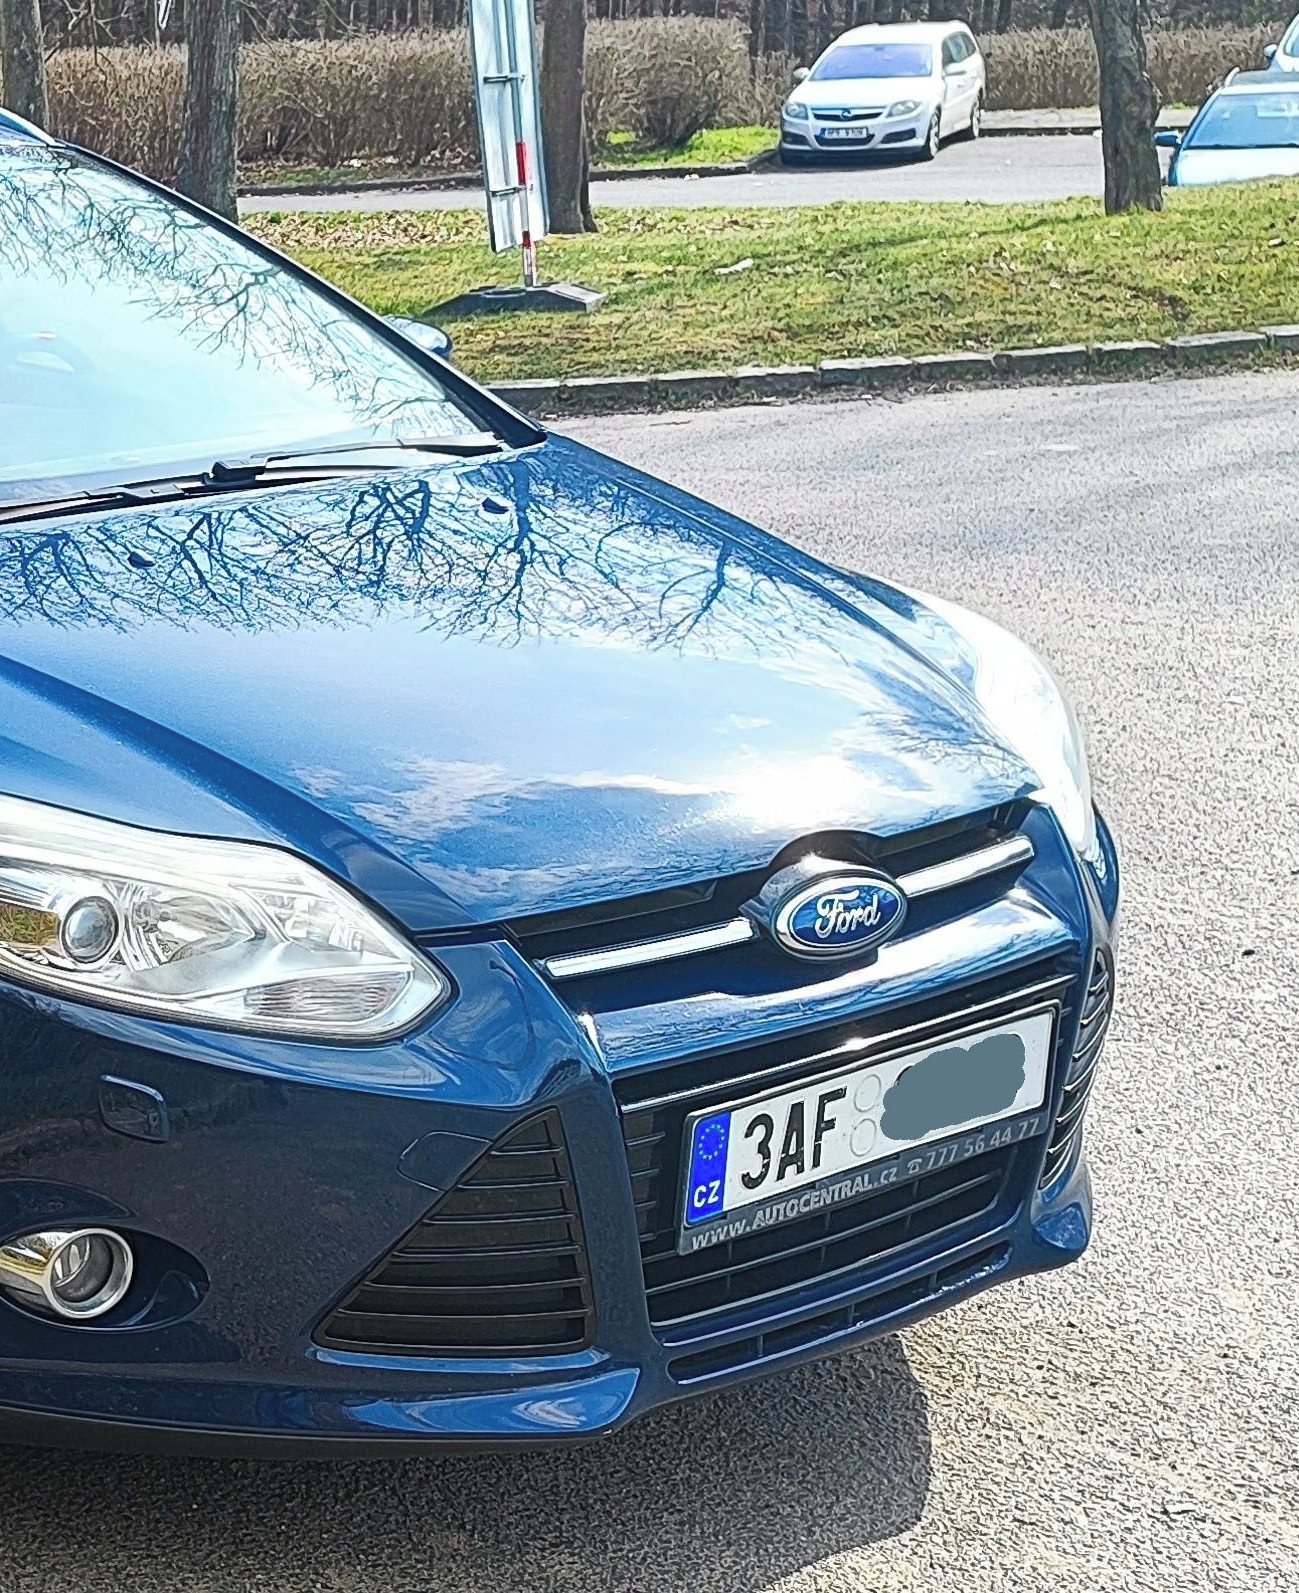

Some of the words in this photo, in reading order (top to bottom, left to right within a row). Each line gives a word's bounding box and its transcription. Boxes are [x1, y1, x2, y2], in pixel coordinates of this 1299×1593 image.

[815, 889, 881, 938] Ford
[740, 1085, 848, 1190] 3AF
[926, 1143, 959, 1170] 777
[963, 1134, 985, 1157] 56
[989, 1126, 1012, 1147] 44
[1018, 1118, 1040, 1142] 77
[693, 1179, 721, 1208] CZ
